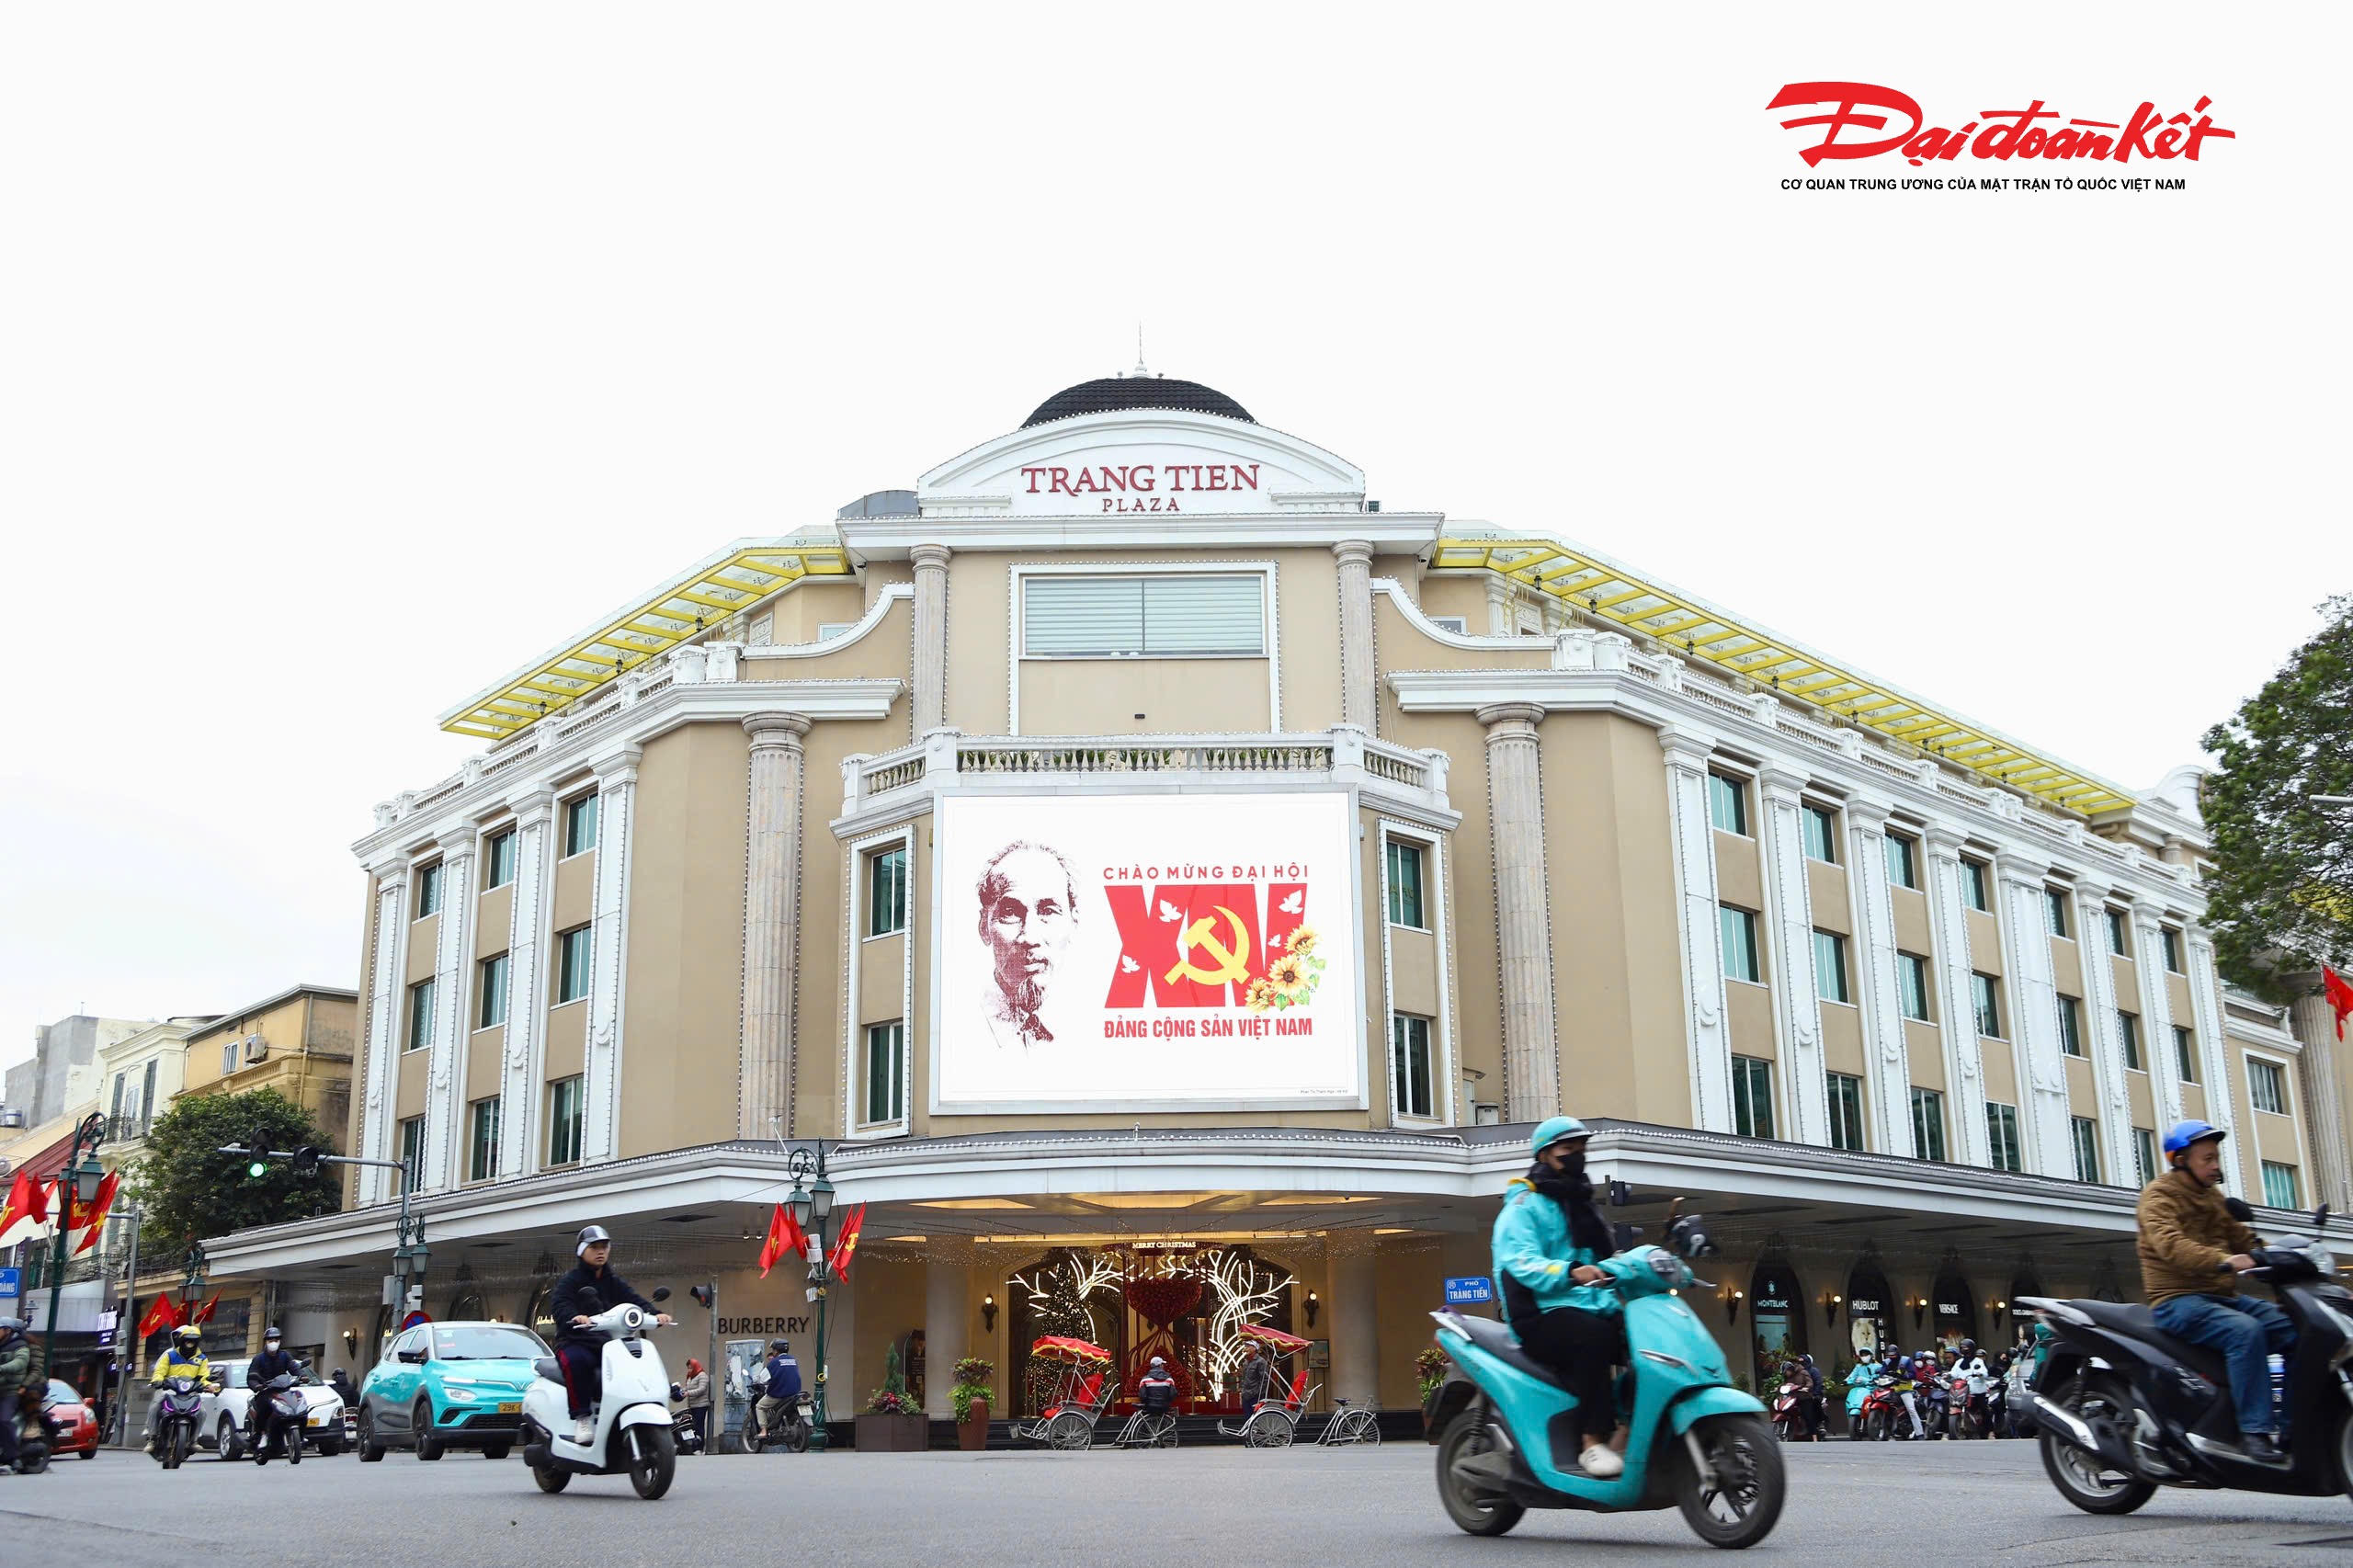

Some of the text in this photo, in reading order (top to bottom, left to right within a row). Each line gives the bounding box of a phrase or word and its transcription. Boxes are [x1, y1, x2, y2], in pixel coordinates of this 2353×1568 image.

[1021, 464, 1260, 496] TRANG TIEN
[1102, 497, 1180, 512] PLAZA
[1103, 862, 1308, 881] CHÀO MỪNG ĐẠI HỘI
[1104, 883, 1307, 1008] XIV
[1104, 1014, 1313, 1041] ĐẢNG CỘNG SẢN VIỆT NAM
[1449, 1289, 1472, 1300] TRÀNG
[1757, 1300, 1788, 1308] MONTBLANC
[1852, 1300, 1880, 1311] HUBLOT
[718, 1317, 810, 1334] BURBERRY
